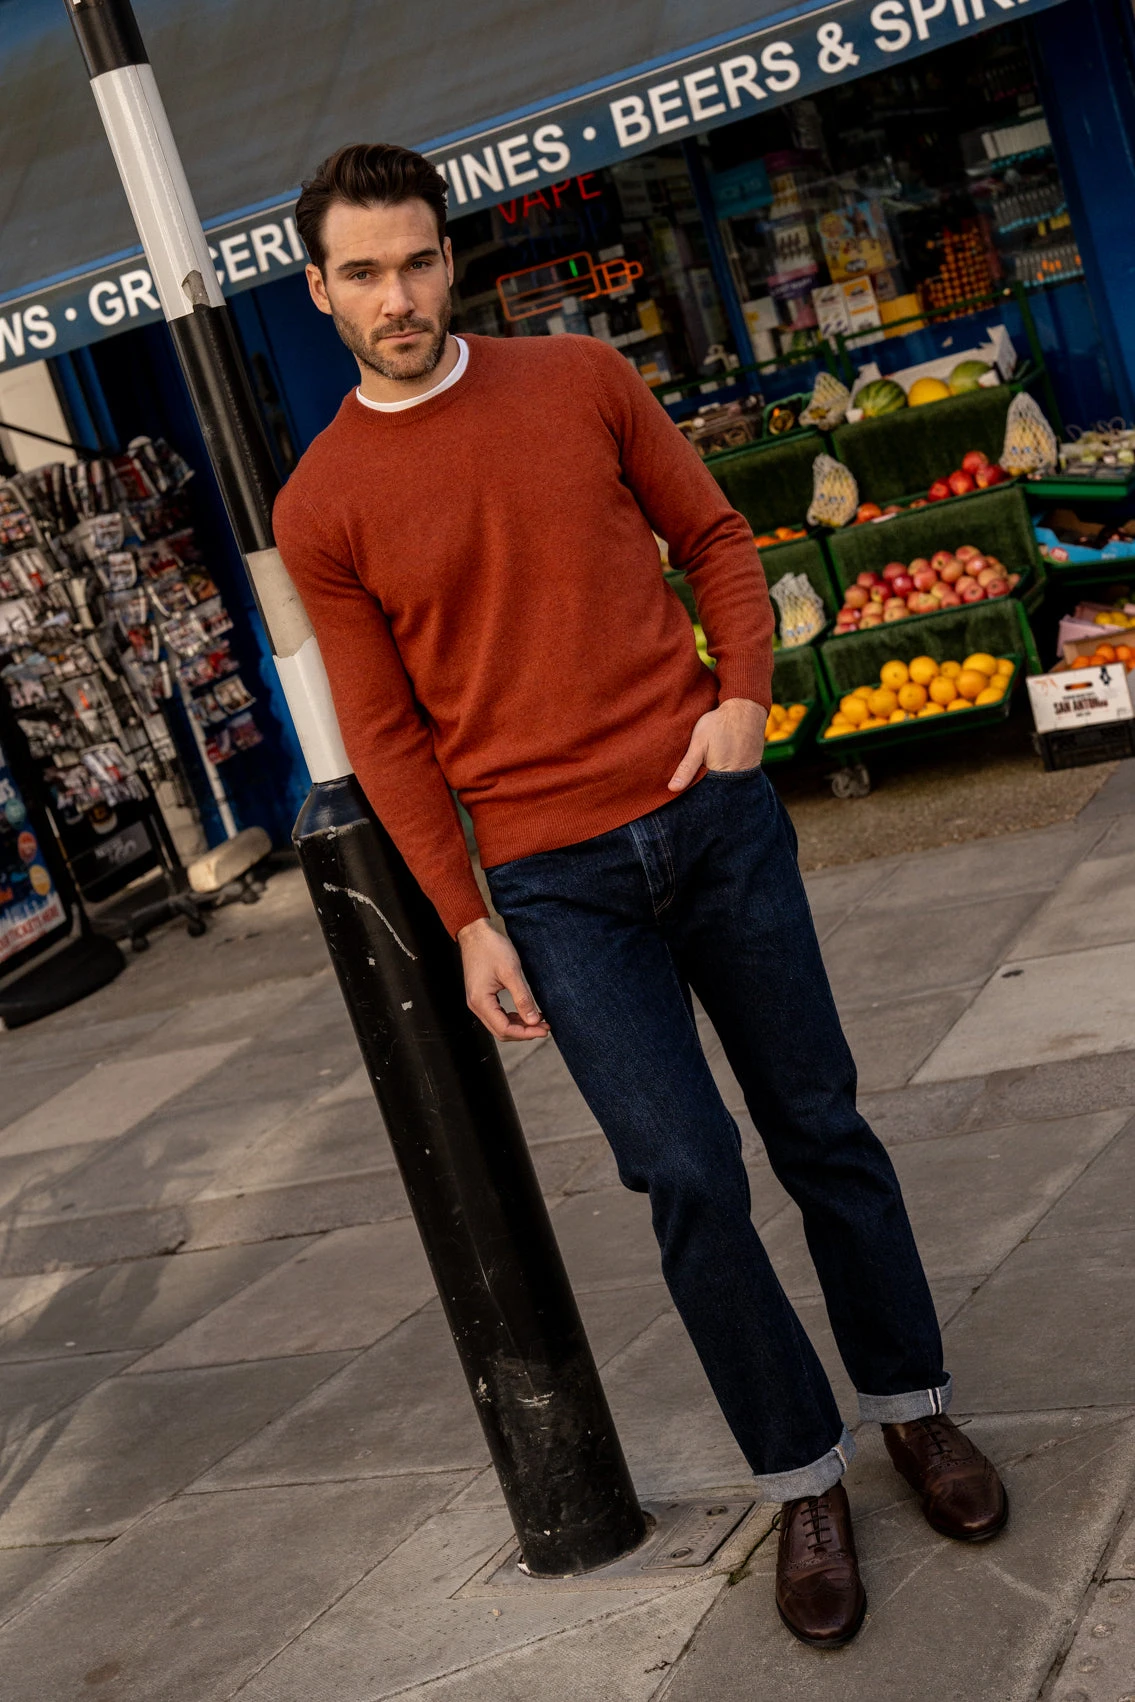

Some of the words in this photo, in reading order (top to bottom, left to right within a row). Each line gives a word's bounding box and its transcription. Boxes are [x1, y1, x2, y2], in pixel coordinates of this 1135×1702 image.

[609, 41, 801, 149] BEERS
[816, 22, 860, 74] &
[497, 171, 603, 224] VAPE
